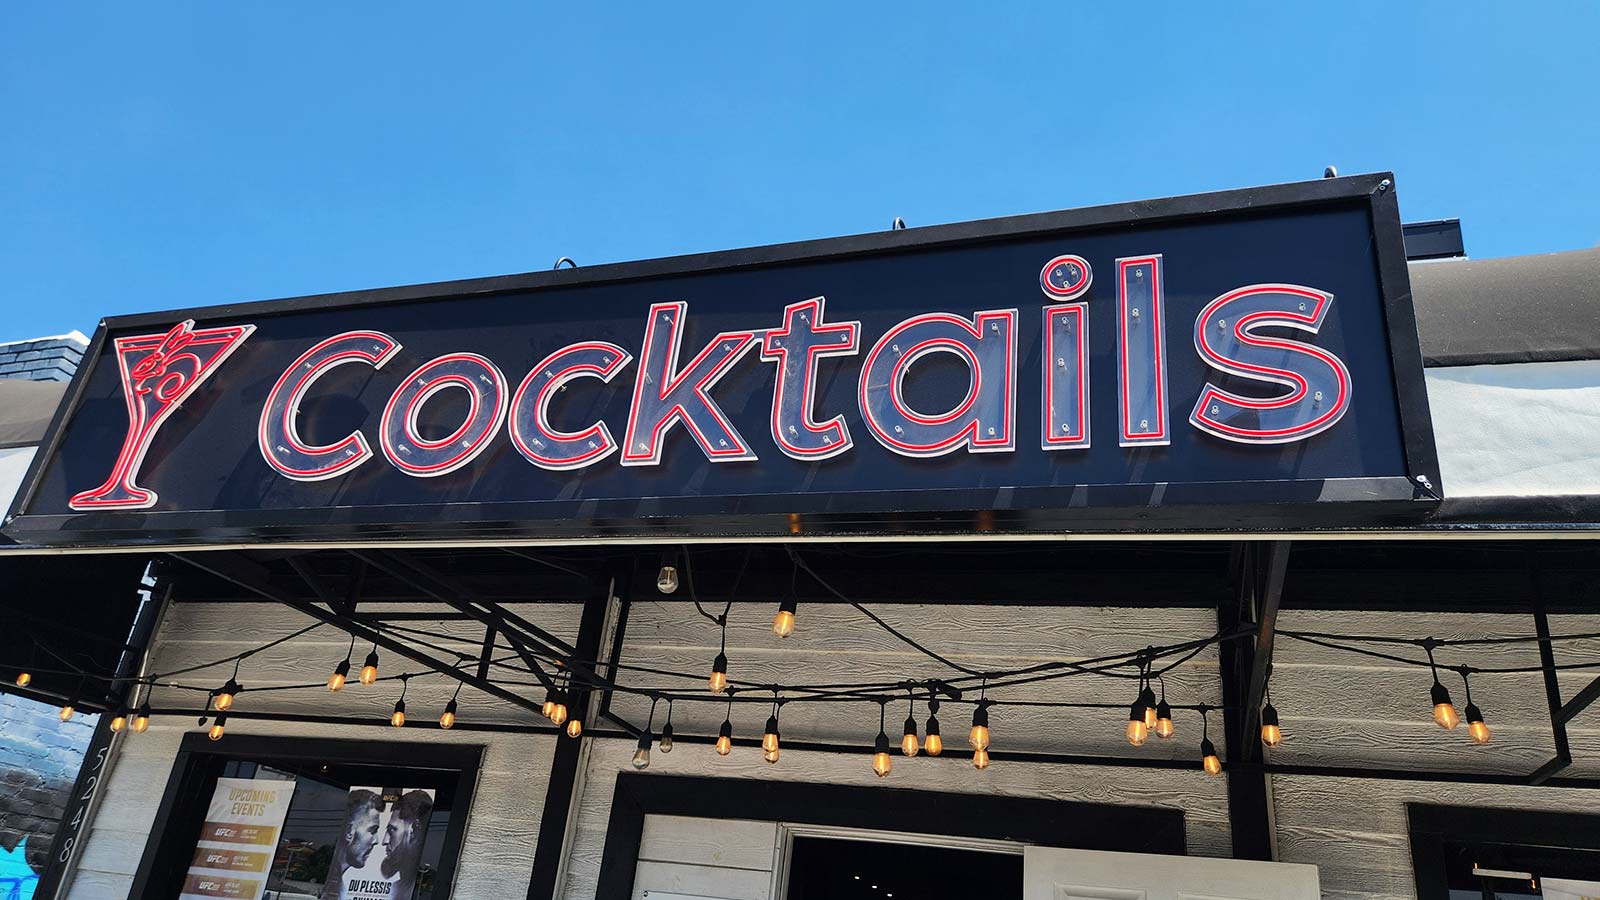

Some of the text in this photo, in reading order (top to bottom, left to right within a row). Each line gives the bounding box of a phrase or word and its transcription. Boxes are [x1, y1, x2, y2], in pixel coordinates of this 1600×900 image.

[258, 253, 1352, 481] Cocktails
[228, 788, 277, 803] UPCOMING
[59, 747, 108, 863] 5248
[231, 802, 265, 816] EVENTS
[348, 880, 360, 892] DU
[360, 880, 392, 895] PLESSIS
